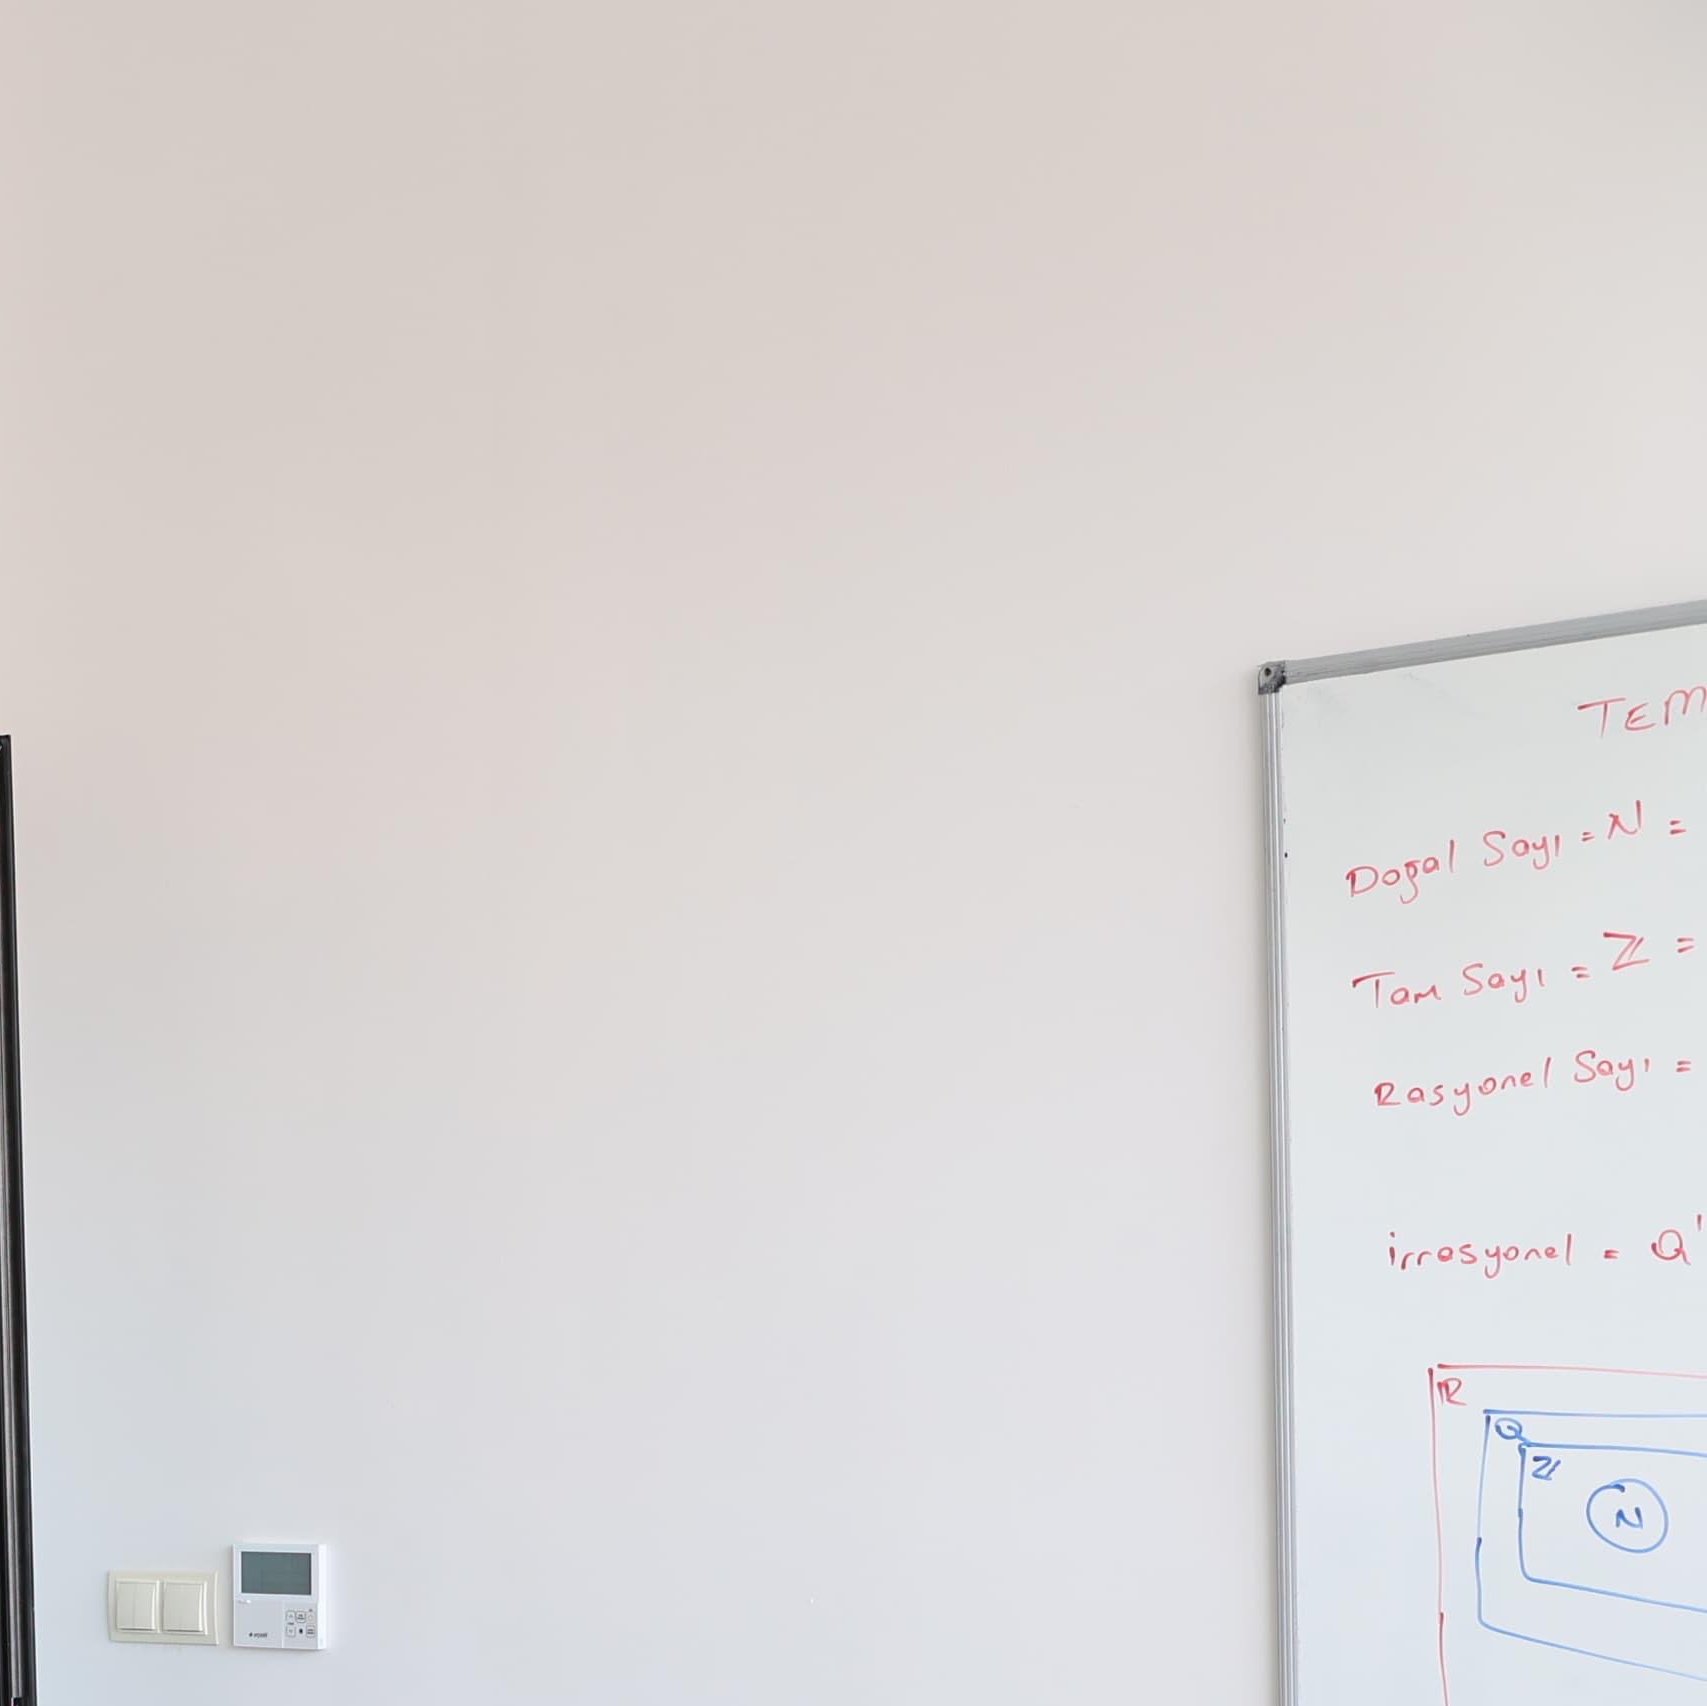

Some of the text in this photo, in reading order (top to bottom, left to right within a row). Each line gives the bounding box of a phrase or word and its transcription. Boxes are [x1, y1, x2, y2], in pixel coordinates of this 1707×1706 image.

[1483, 830, 1561, 870] Sayı
[1352, 971, 1442, 1008] Tam
[1462, 963, 1545, 1003] Sayı
[1374, 1056, 1552, 1116] Rasyonel
[1573, 1050, 1650, 1092] Sayı
